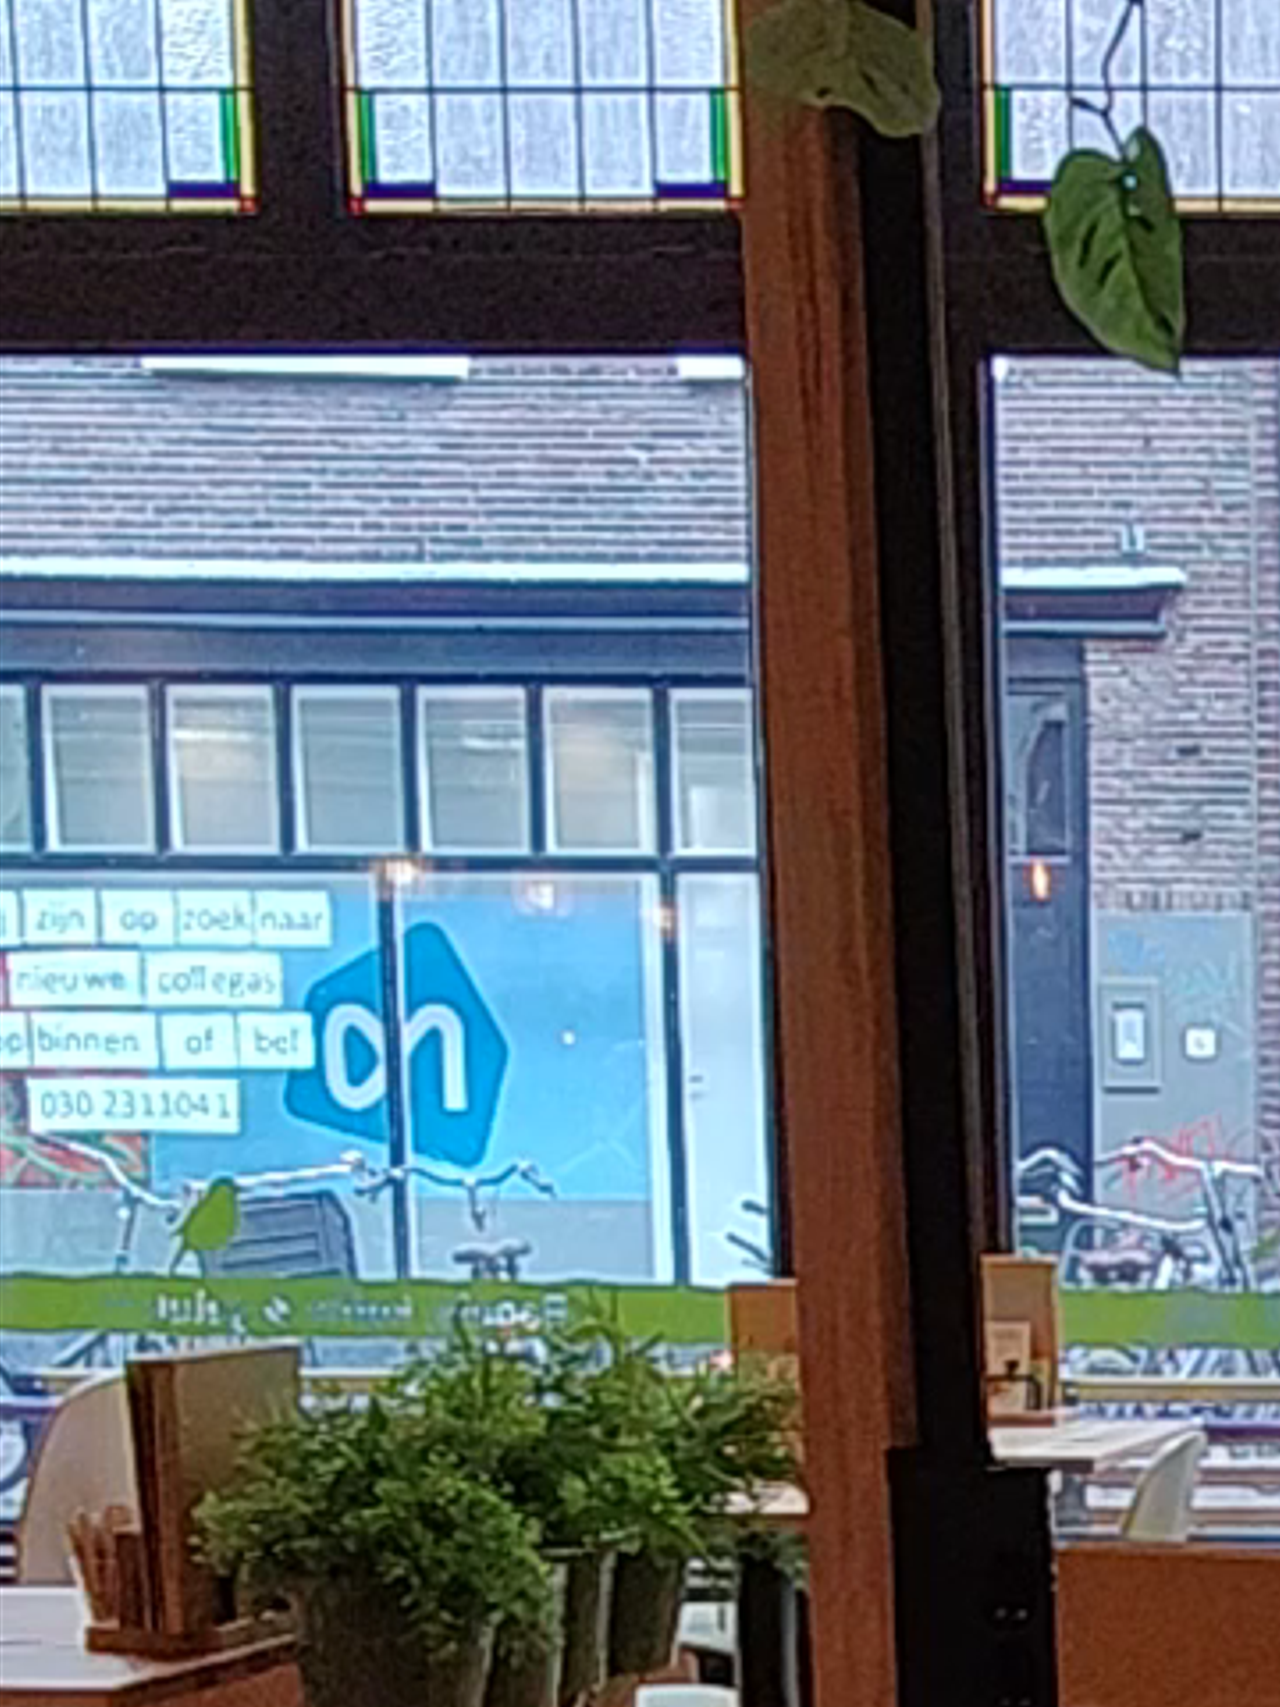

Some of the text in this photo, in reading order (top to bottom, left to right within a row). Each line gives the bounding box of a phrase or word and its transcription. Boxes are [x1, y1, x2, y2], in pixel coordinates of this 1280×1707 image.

[36, 900, 85, 934] zijn
[119, 909, 158, 932] op
[183, 901, 247, 931] zoek
[260, 909, 323, 931] naar
[16, 965, 127, 994] nieuwe
[37, 1024, 140, 1055] binnen
[185, 1027, 213, 1054] of
[254, 1027, 299, 1055] bel
[40, 1091, 93, 1119] 030
